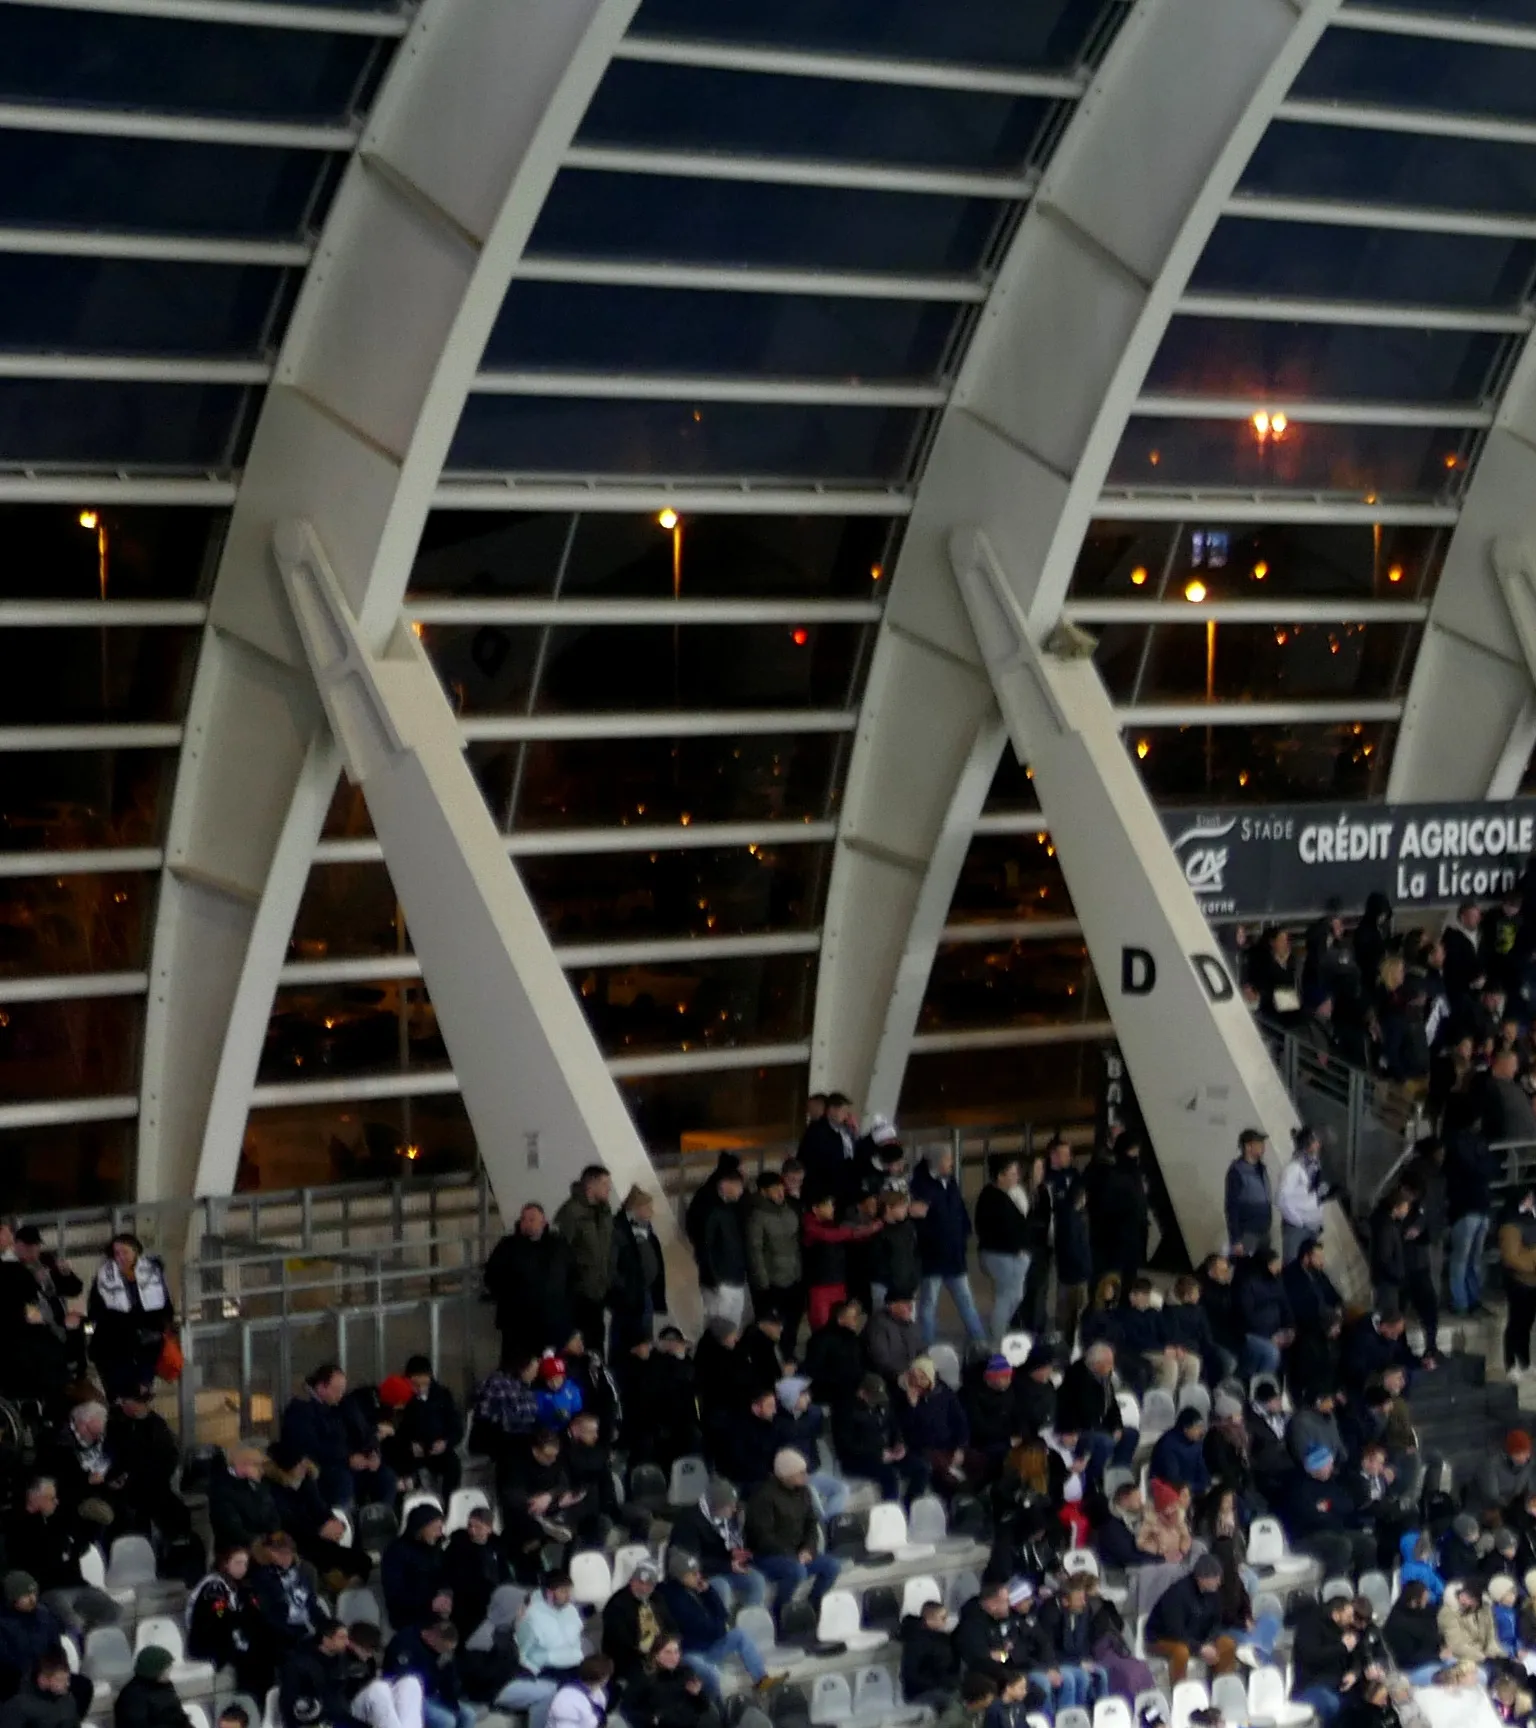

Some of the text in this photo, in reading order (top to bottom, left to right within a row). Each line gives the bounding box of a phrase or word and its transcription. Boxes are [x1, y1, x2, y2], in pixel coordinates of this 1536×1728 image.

[1299, 814, 1394, 864] CRÉDIT
[1400, 815, 1535, 858] AGRICOLE
[1396, 864, 1426, 899] La
[1121, 945, 1156, 995] D
[1190, 953, 1235, 1002] D
